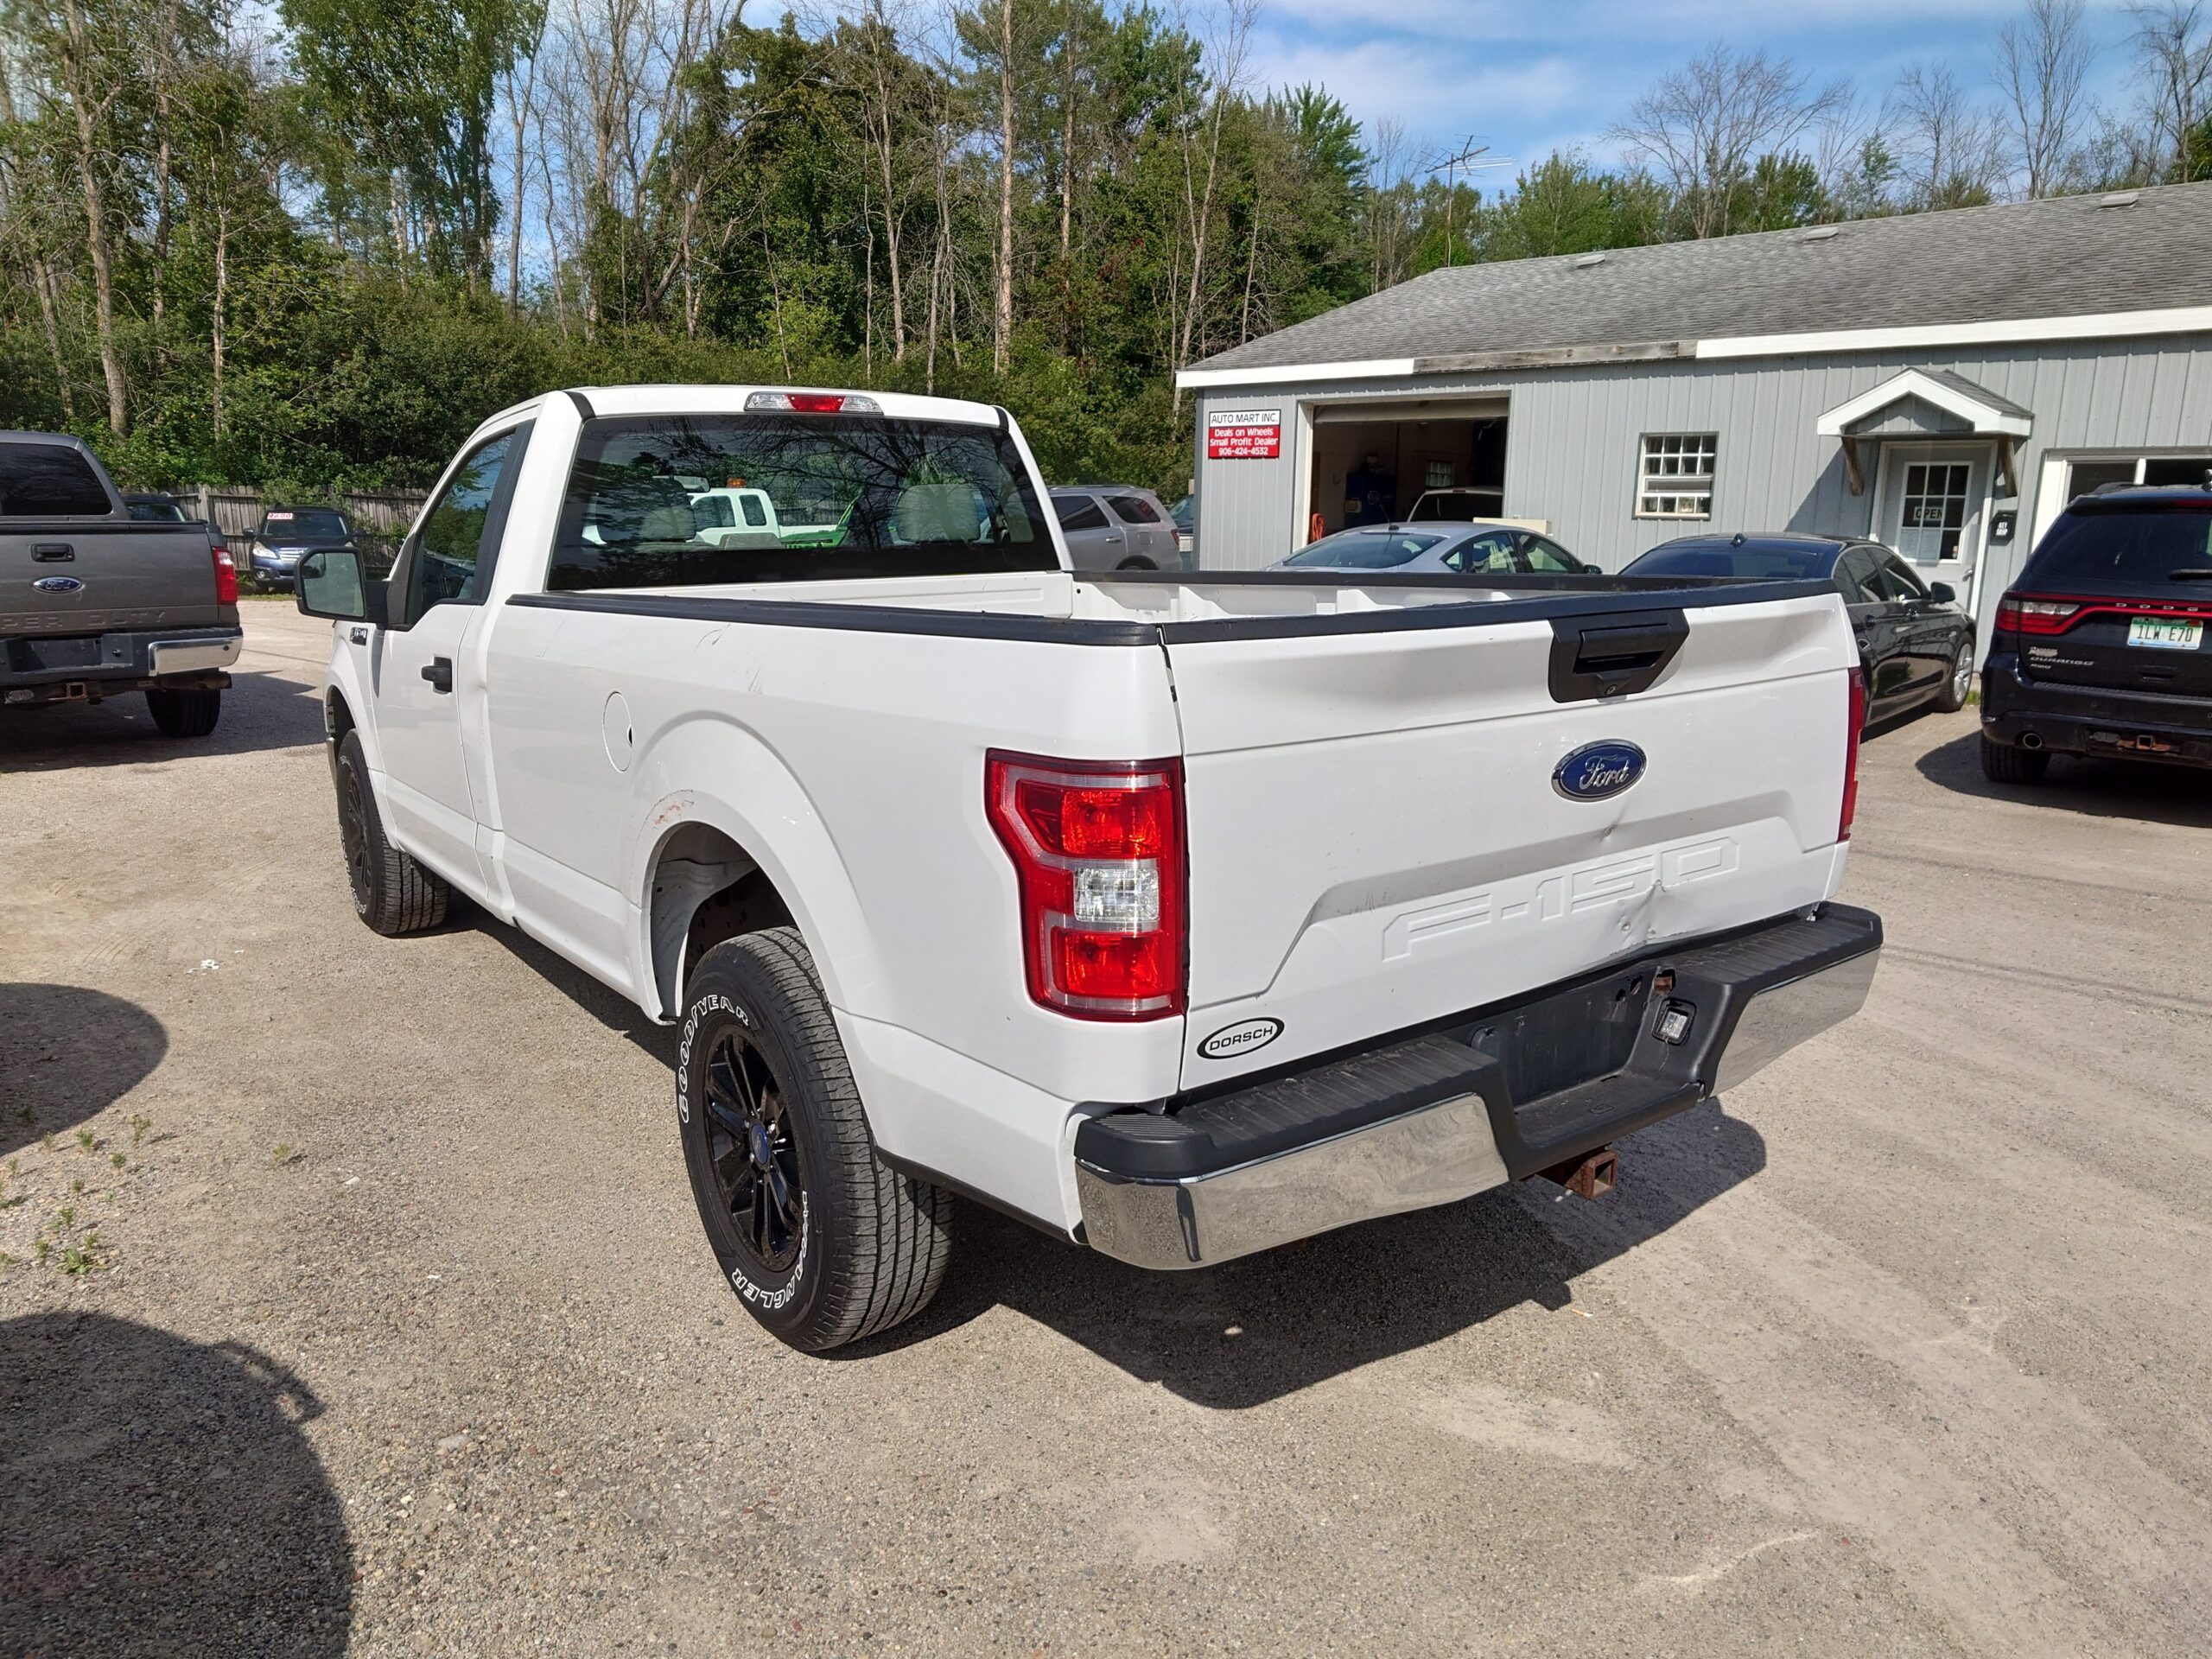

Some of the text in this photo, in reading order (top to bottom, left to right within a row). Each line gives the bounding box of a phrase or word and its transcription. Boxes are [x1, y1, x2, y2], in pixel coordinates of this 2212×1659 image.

[1211, 413, 1278, 423] AUTO MART INC.
[1247, 427, 1274, 435] Wheels
[1218, 447, 1268, 455] 906-424-4532
[1916, 508, 1943, 518] OPEN
[2116, 602, 2212, 613] DODG
[2031, 657, 2094, 665] DURANGO
[1579, 754, 1630, 790] Ford
[1382, 836, 1739, 962] F-150
[1210, 1026, 1274, 1051] DORSCH
[678, 994, 749, 1123] GOODYEAR
[731, 1191, 809, 1308] WRANGLER
